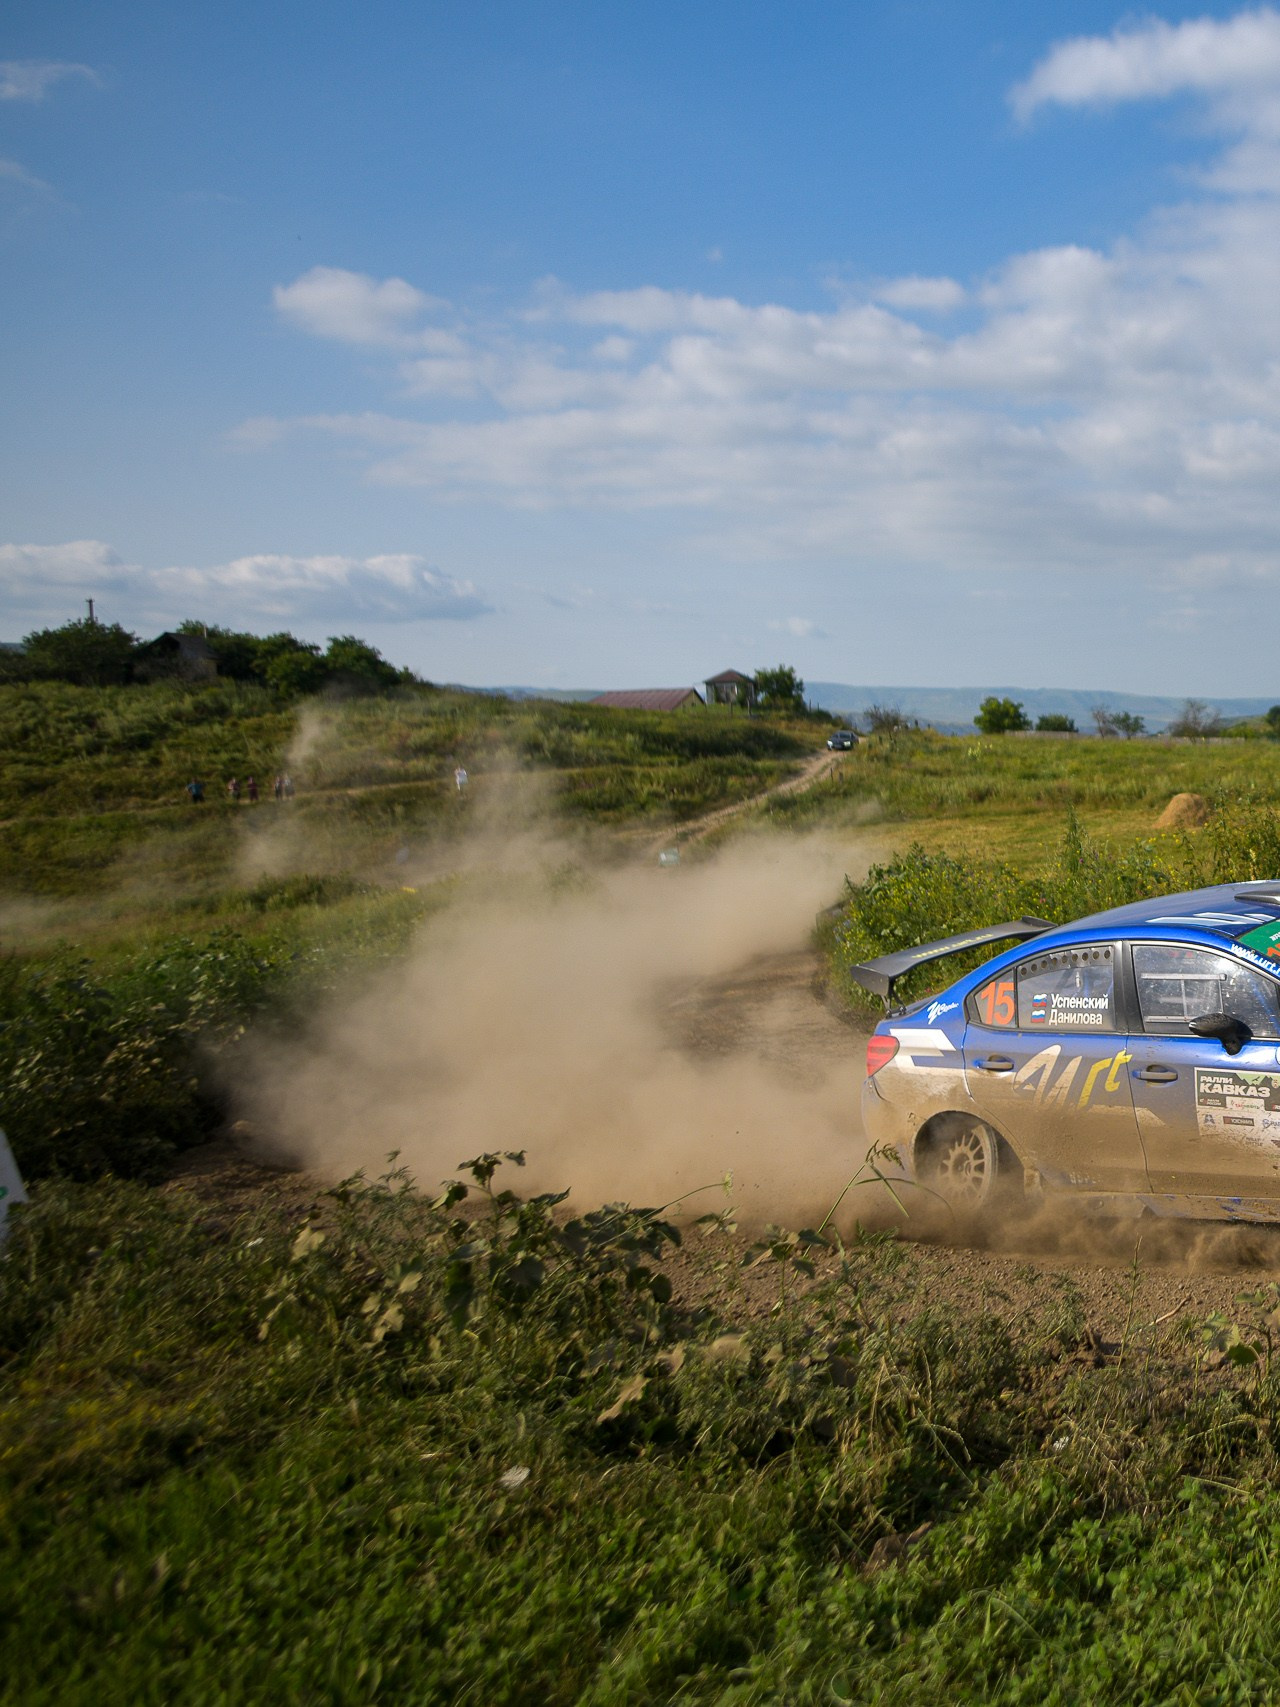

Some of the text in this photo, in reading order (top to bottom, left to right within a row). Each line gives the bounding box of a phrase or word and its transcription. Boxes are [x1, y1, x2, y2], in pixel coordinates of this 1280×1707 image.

[980, 982, 1016, 1025] 15
[1051, 993, 1109, 1010] Успенский
[1049, 1009, 1103, 1026] Данилова
[1200, 1075, 1233, 1085] РАЛЛИ
[1199, 1082, 1271, 1098] КАВКАЗ
